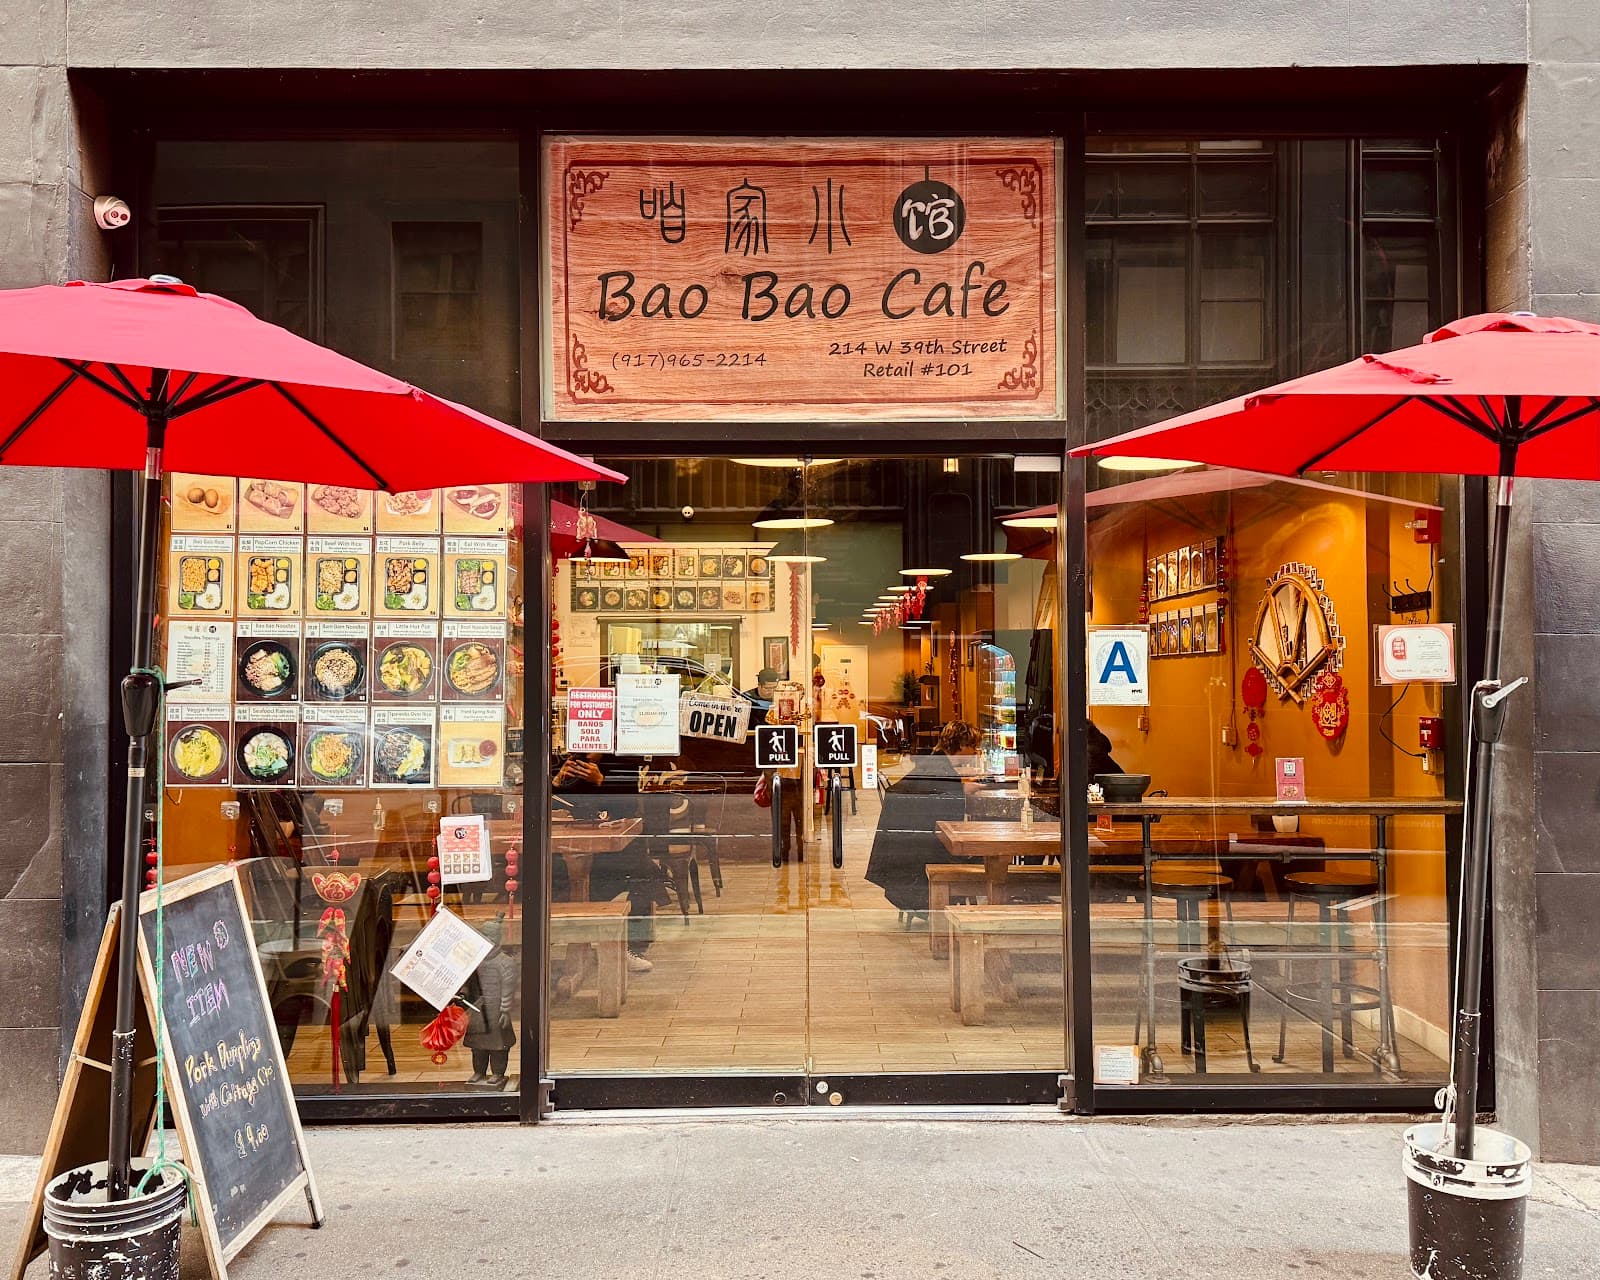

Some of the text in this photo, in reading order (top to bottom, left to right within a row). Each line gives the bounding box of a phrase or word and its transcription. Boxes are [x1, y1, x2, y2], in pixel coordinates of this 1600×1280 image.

[597, 260, 1010, 322] Bao Bao Cafe
[828, 338, 1008, 356] 214 W 39th Street
[611, 351, 767, 371] (917)965-2214
[863, 360, 973, 377] Retail #101
[1098, 640, 1138, 684] A
[569, 701, 581, 709] FOR
[577, 709, 604, 719] ONLY
[689, 710, 738, 738] OPEN
[768, 753, 791, 762] PULL
[828, 752, 850, 761] PULL
[171, 940, 214, 983] NEW
[186, 977, 232, 1027] ITEM
[185, 1050, 218, 1089] Pork
